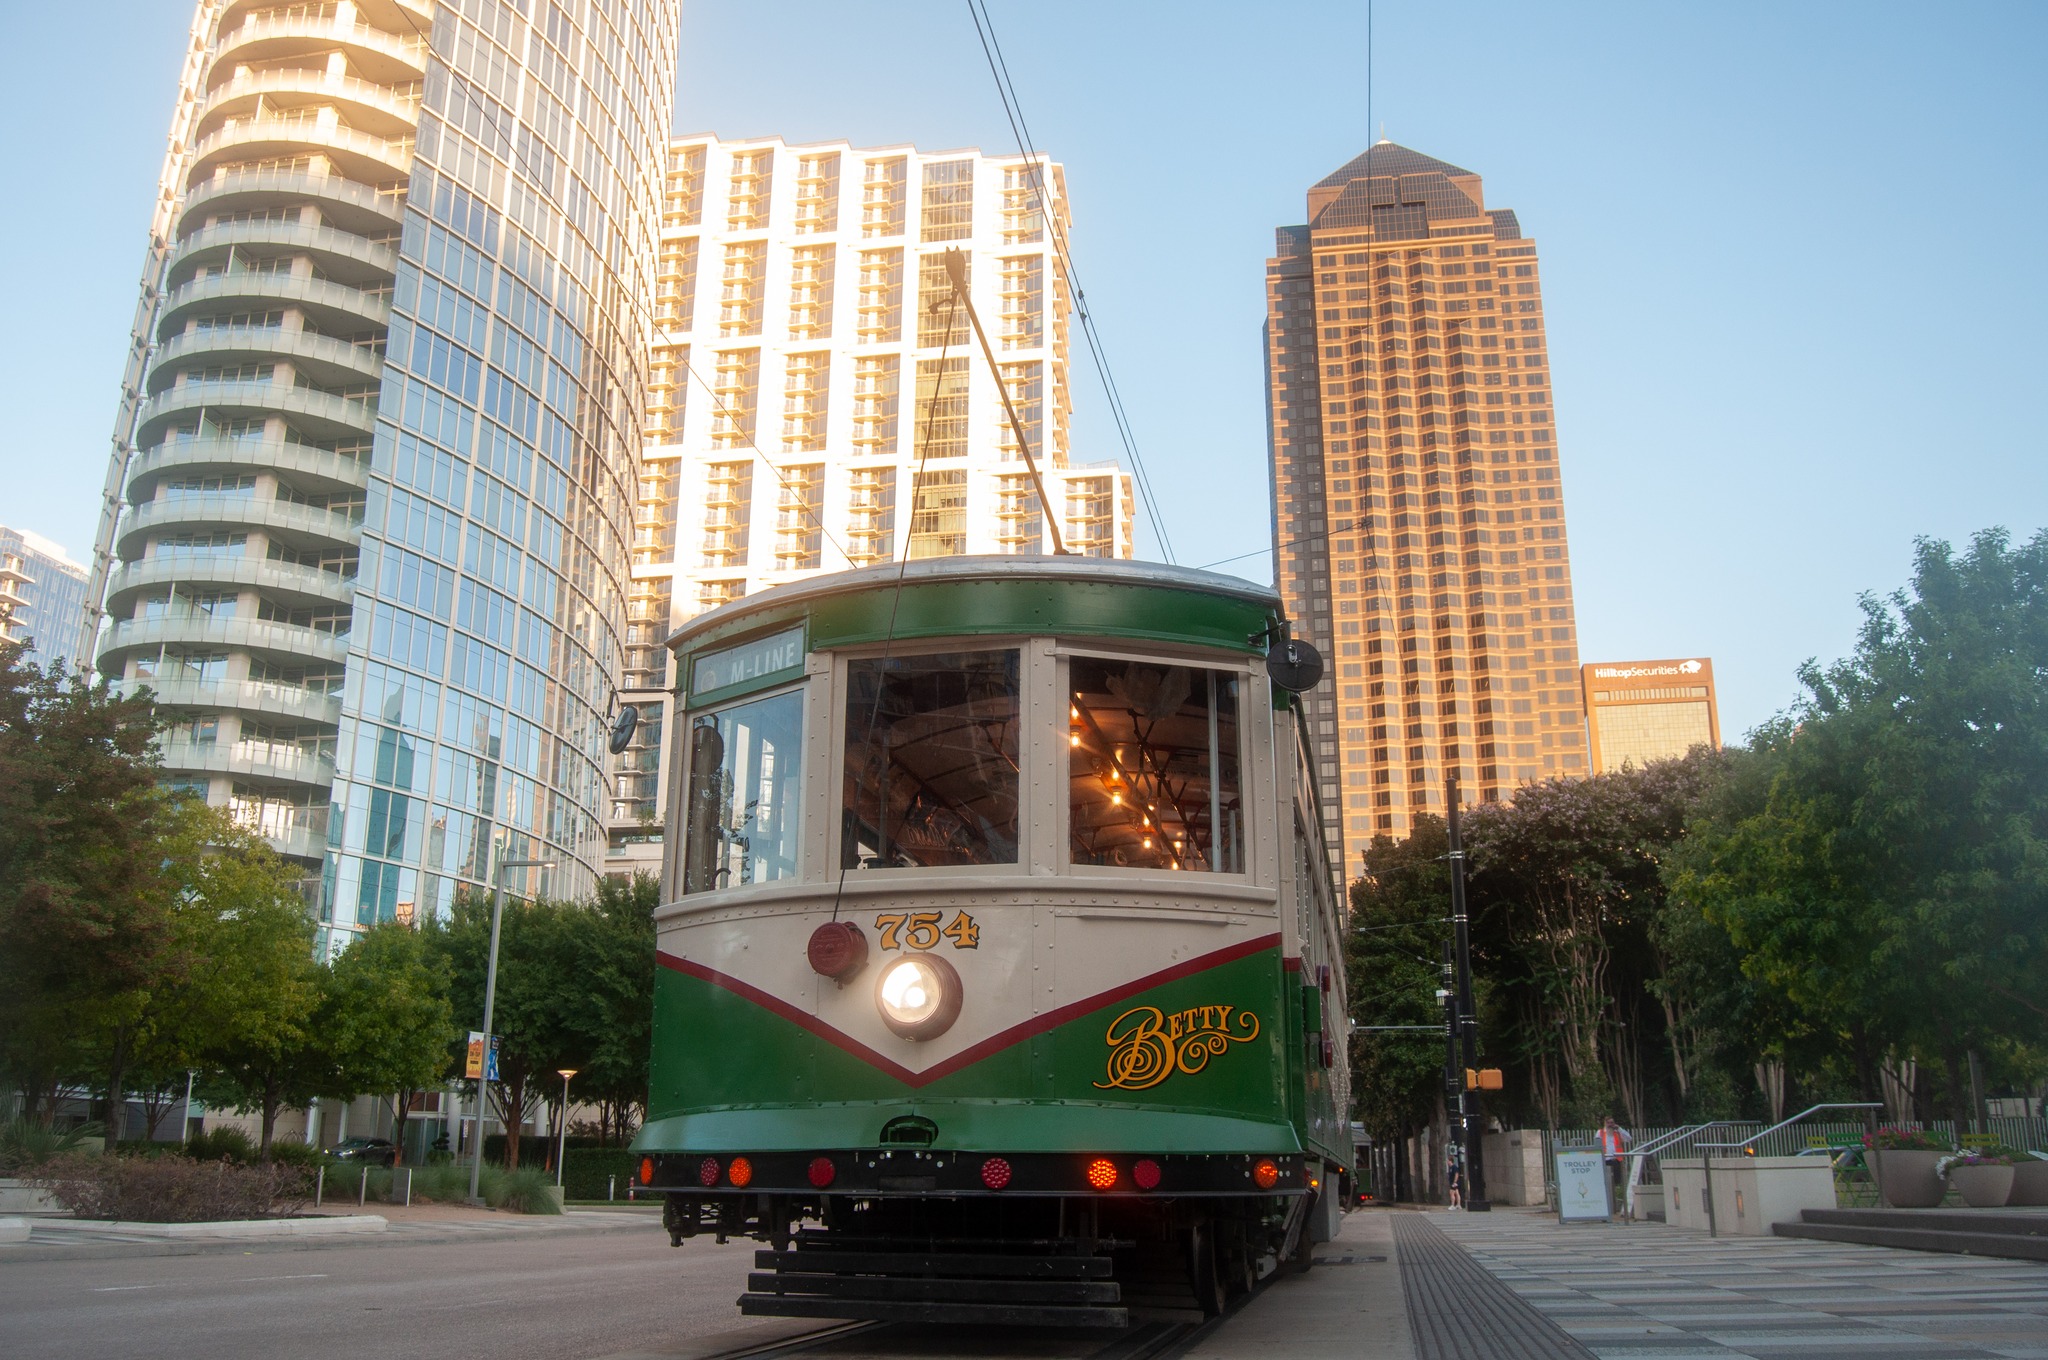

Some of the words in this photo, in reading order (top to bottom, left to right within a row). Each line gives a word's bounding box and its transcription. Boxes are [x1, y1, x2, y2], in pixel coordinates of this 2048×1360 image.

[729, 642, 795, 684] M-LINE
[1595, 666, 1678, 678] HilltopSecurities
[874, 909, 981, 951] 754
[1563, 1160, 1597, 1168] TROLLEY
